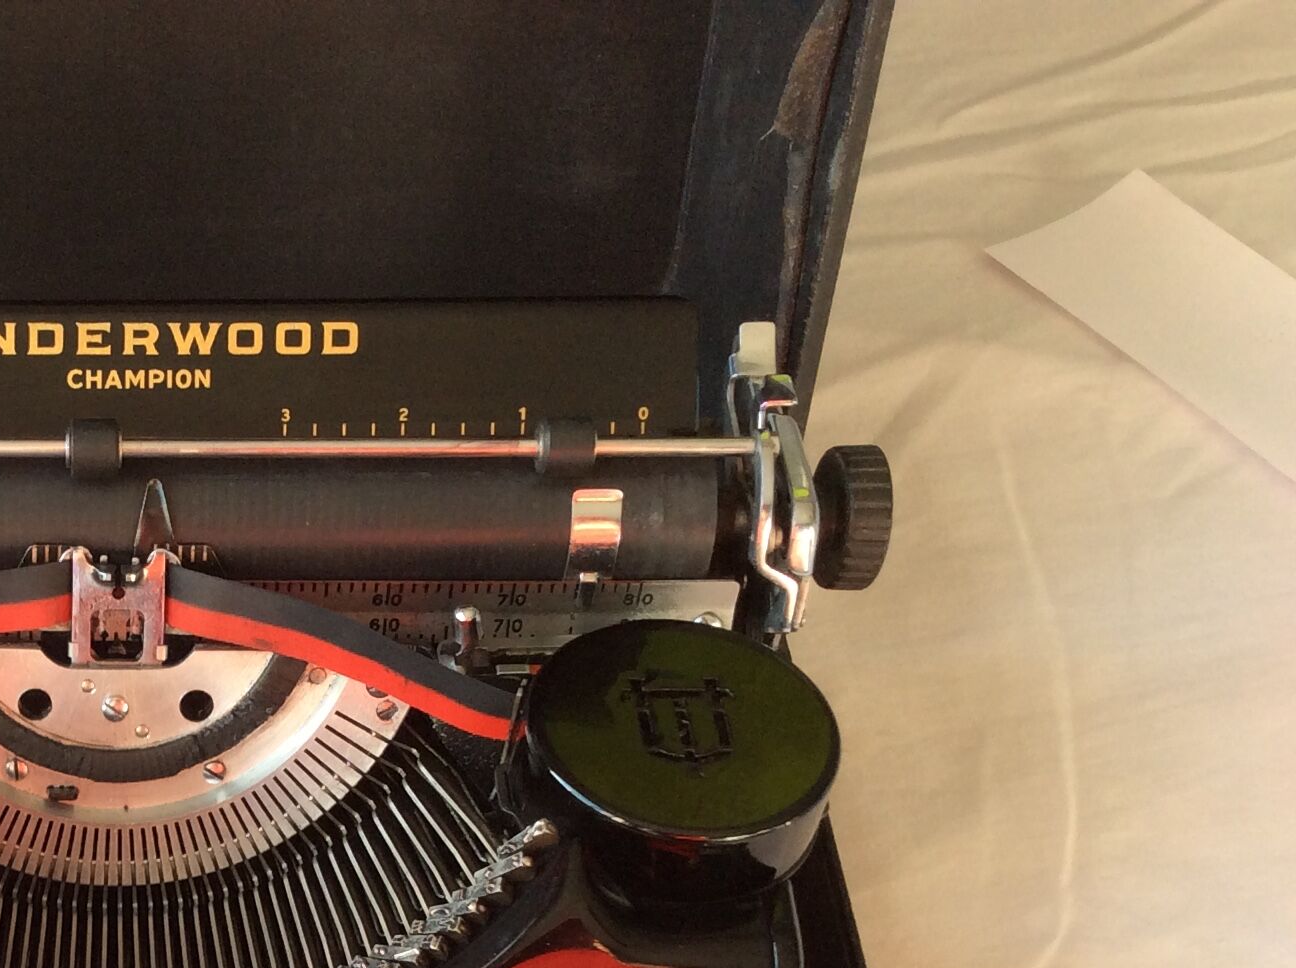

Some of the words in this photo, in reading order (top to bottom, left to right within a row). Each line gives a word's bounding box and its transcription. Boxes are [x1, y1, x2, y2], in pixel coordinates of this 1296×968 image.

[66, 368, 211, 390] CHAMPION
[281, 408, 291, 423] 3
[399, 407, 409, 422] 2
[518, 406, 527, 421] 1
[638, 406, 649, 421] 0
